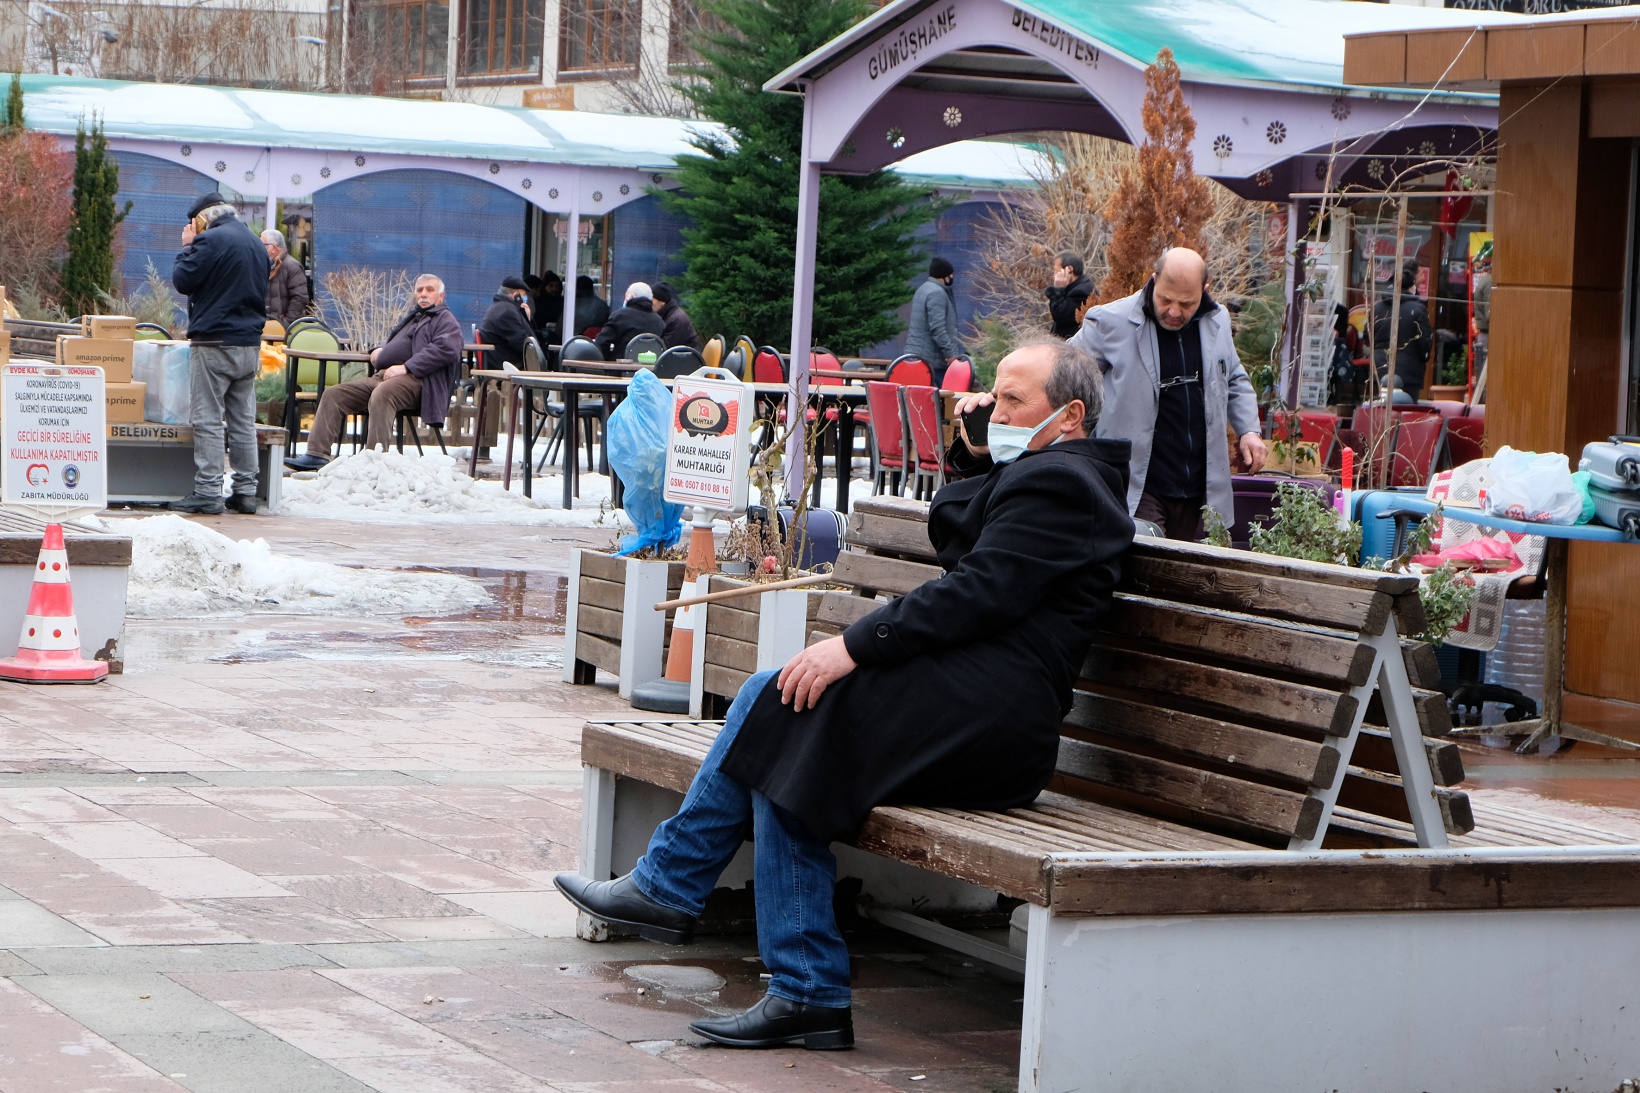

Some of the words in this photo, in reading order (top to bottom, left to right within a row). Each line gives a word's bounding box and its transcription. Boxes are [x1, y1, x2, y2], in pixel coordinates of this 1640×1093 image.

[869, 5, 957, 80] GÜMÜŞHANE
[75, 355, 101, 363] amazon
[102, 355, 125, 363] prime
[68, 368, 96, 376] GÜMÜŞHANE
[26, 379, 57, 389] KORONAVİRÜS
[58, 381, 81, 390] (COVID-19)
[110, 396, 136, 406] prime
[40, 405, 46, 413] VE
[38, 417, 60, 426] KORUMAK
[60, 416, 70, 427] İÇİN
[692, 417, 714, 425] MUHTAR
[17, 429, 39, 444] GEÇİCİ
[40, 429, 51, 443] BİR
[52, 430, 91, 444] SÜRELİĞİNE
[111, 426, 178, 438] BELEDİYESİ
[11, 448, 49, 460] KULLANIMA
[50, 449, 99, 463] KAPATILMIŞTIR
[674, 444, 697, 455] KARAER
[697, 447, 732, 460] MAHALLESİ
[676, 459, 725, 474] MUHTARLIĞI
[670, 478, 684, 487] GSM:
[685, 480, 699, 490] 0507
[700, 482, 712, 492] 810
[712, 484, 720, 493] 88
[721, 485, 730, 494] 16
[46, 492, 89, 501] MÜDÜRLÜĞÜ
